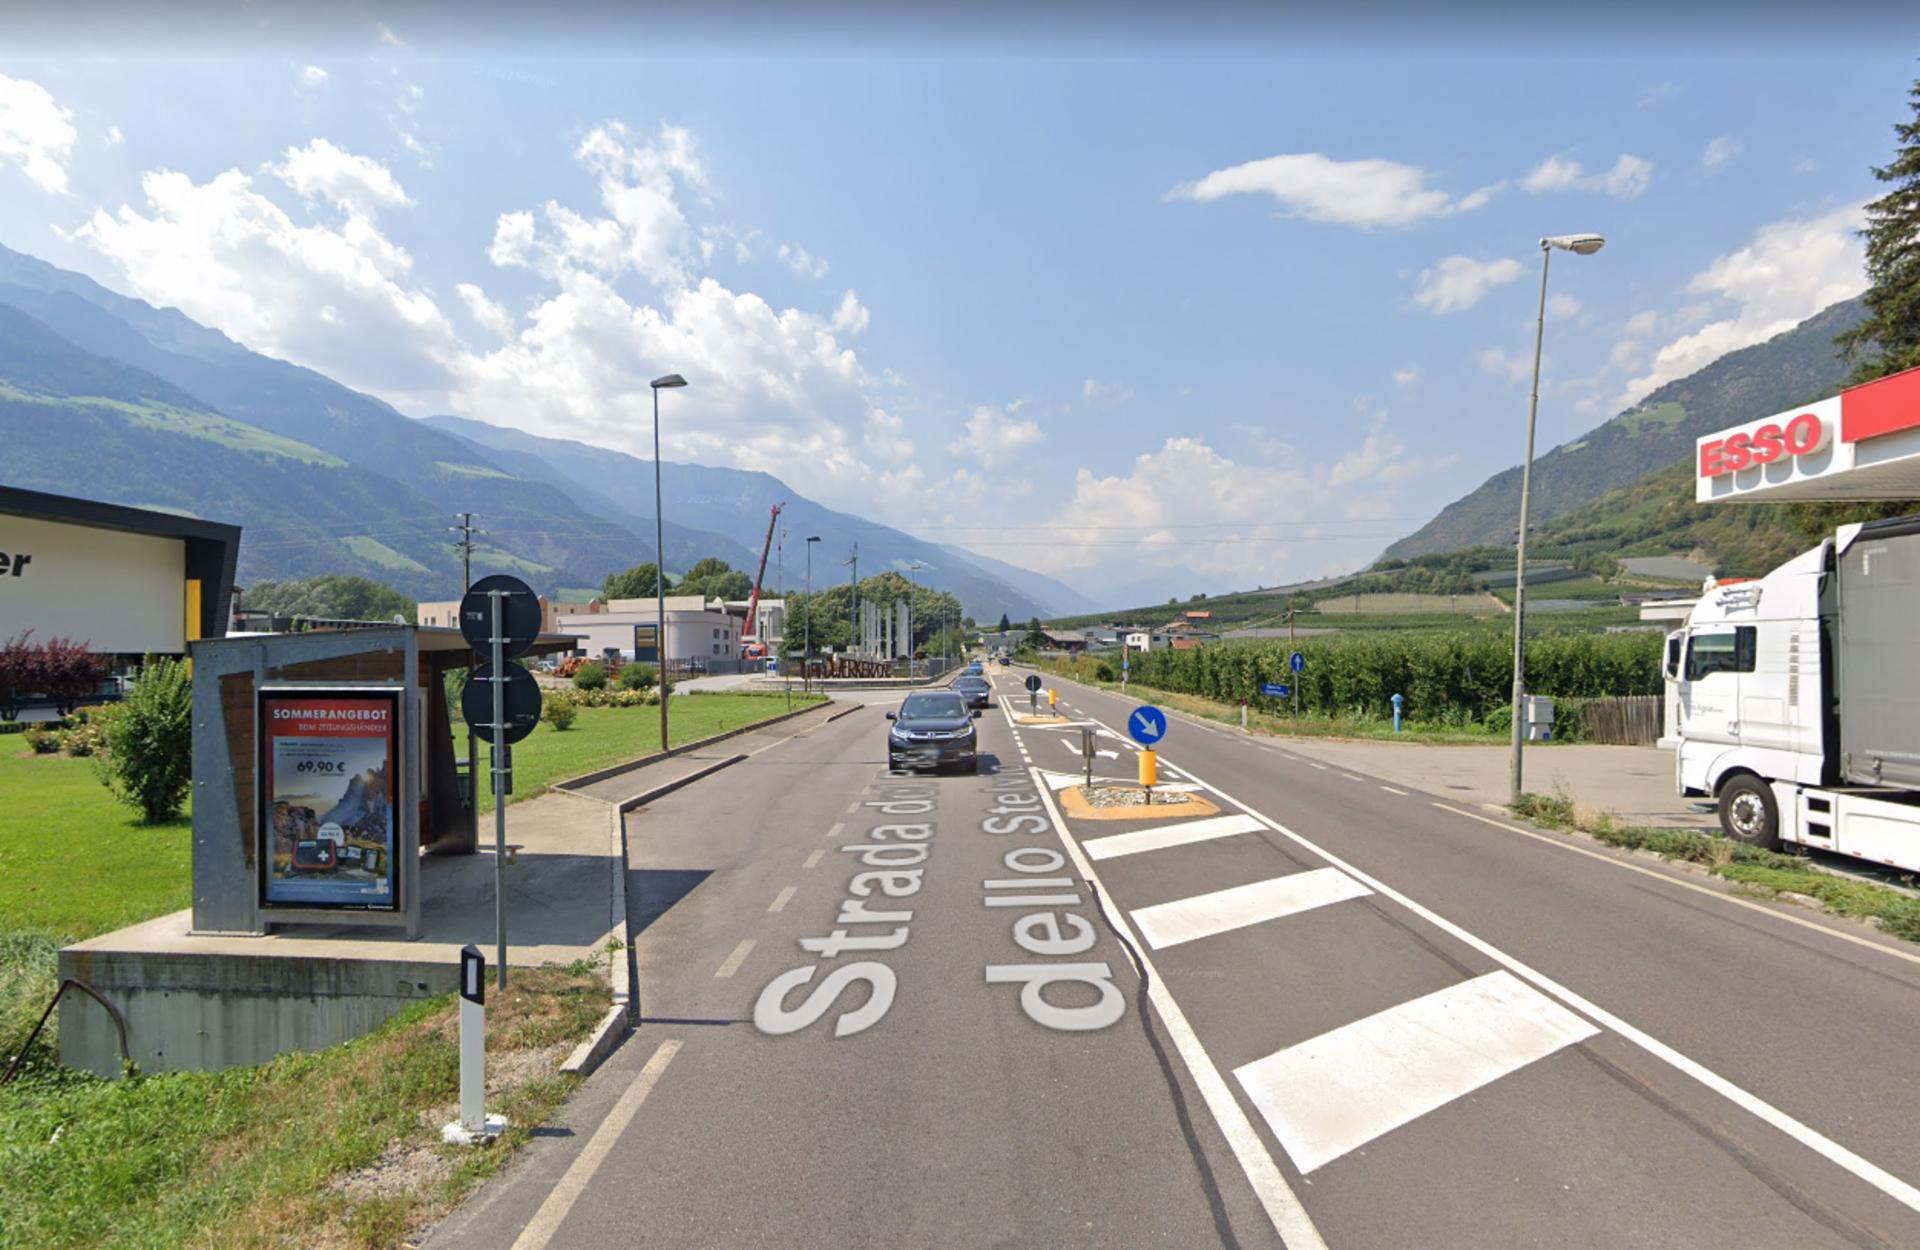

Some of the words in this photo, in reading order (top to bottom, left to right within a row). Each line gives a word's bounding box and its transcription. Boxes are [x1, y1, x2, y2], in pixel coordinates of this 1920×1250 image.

[1701, 413, 1821, 477] ESSO
[273, 708, 387, 720] SOMMERANGEBOT
[297, 761, 334, 773] 69,90
[337, 761, 346, 772] €
